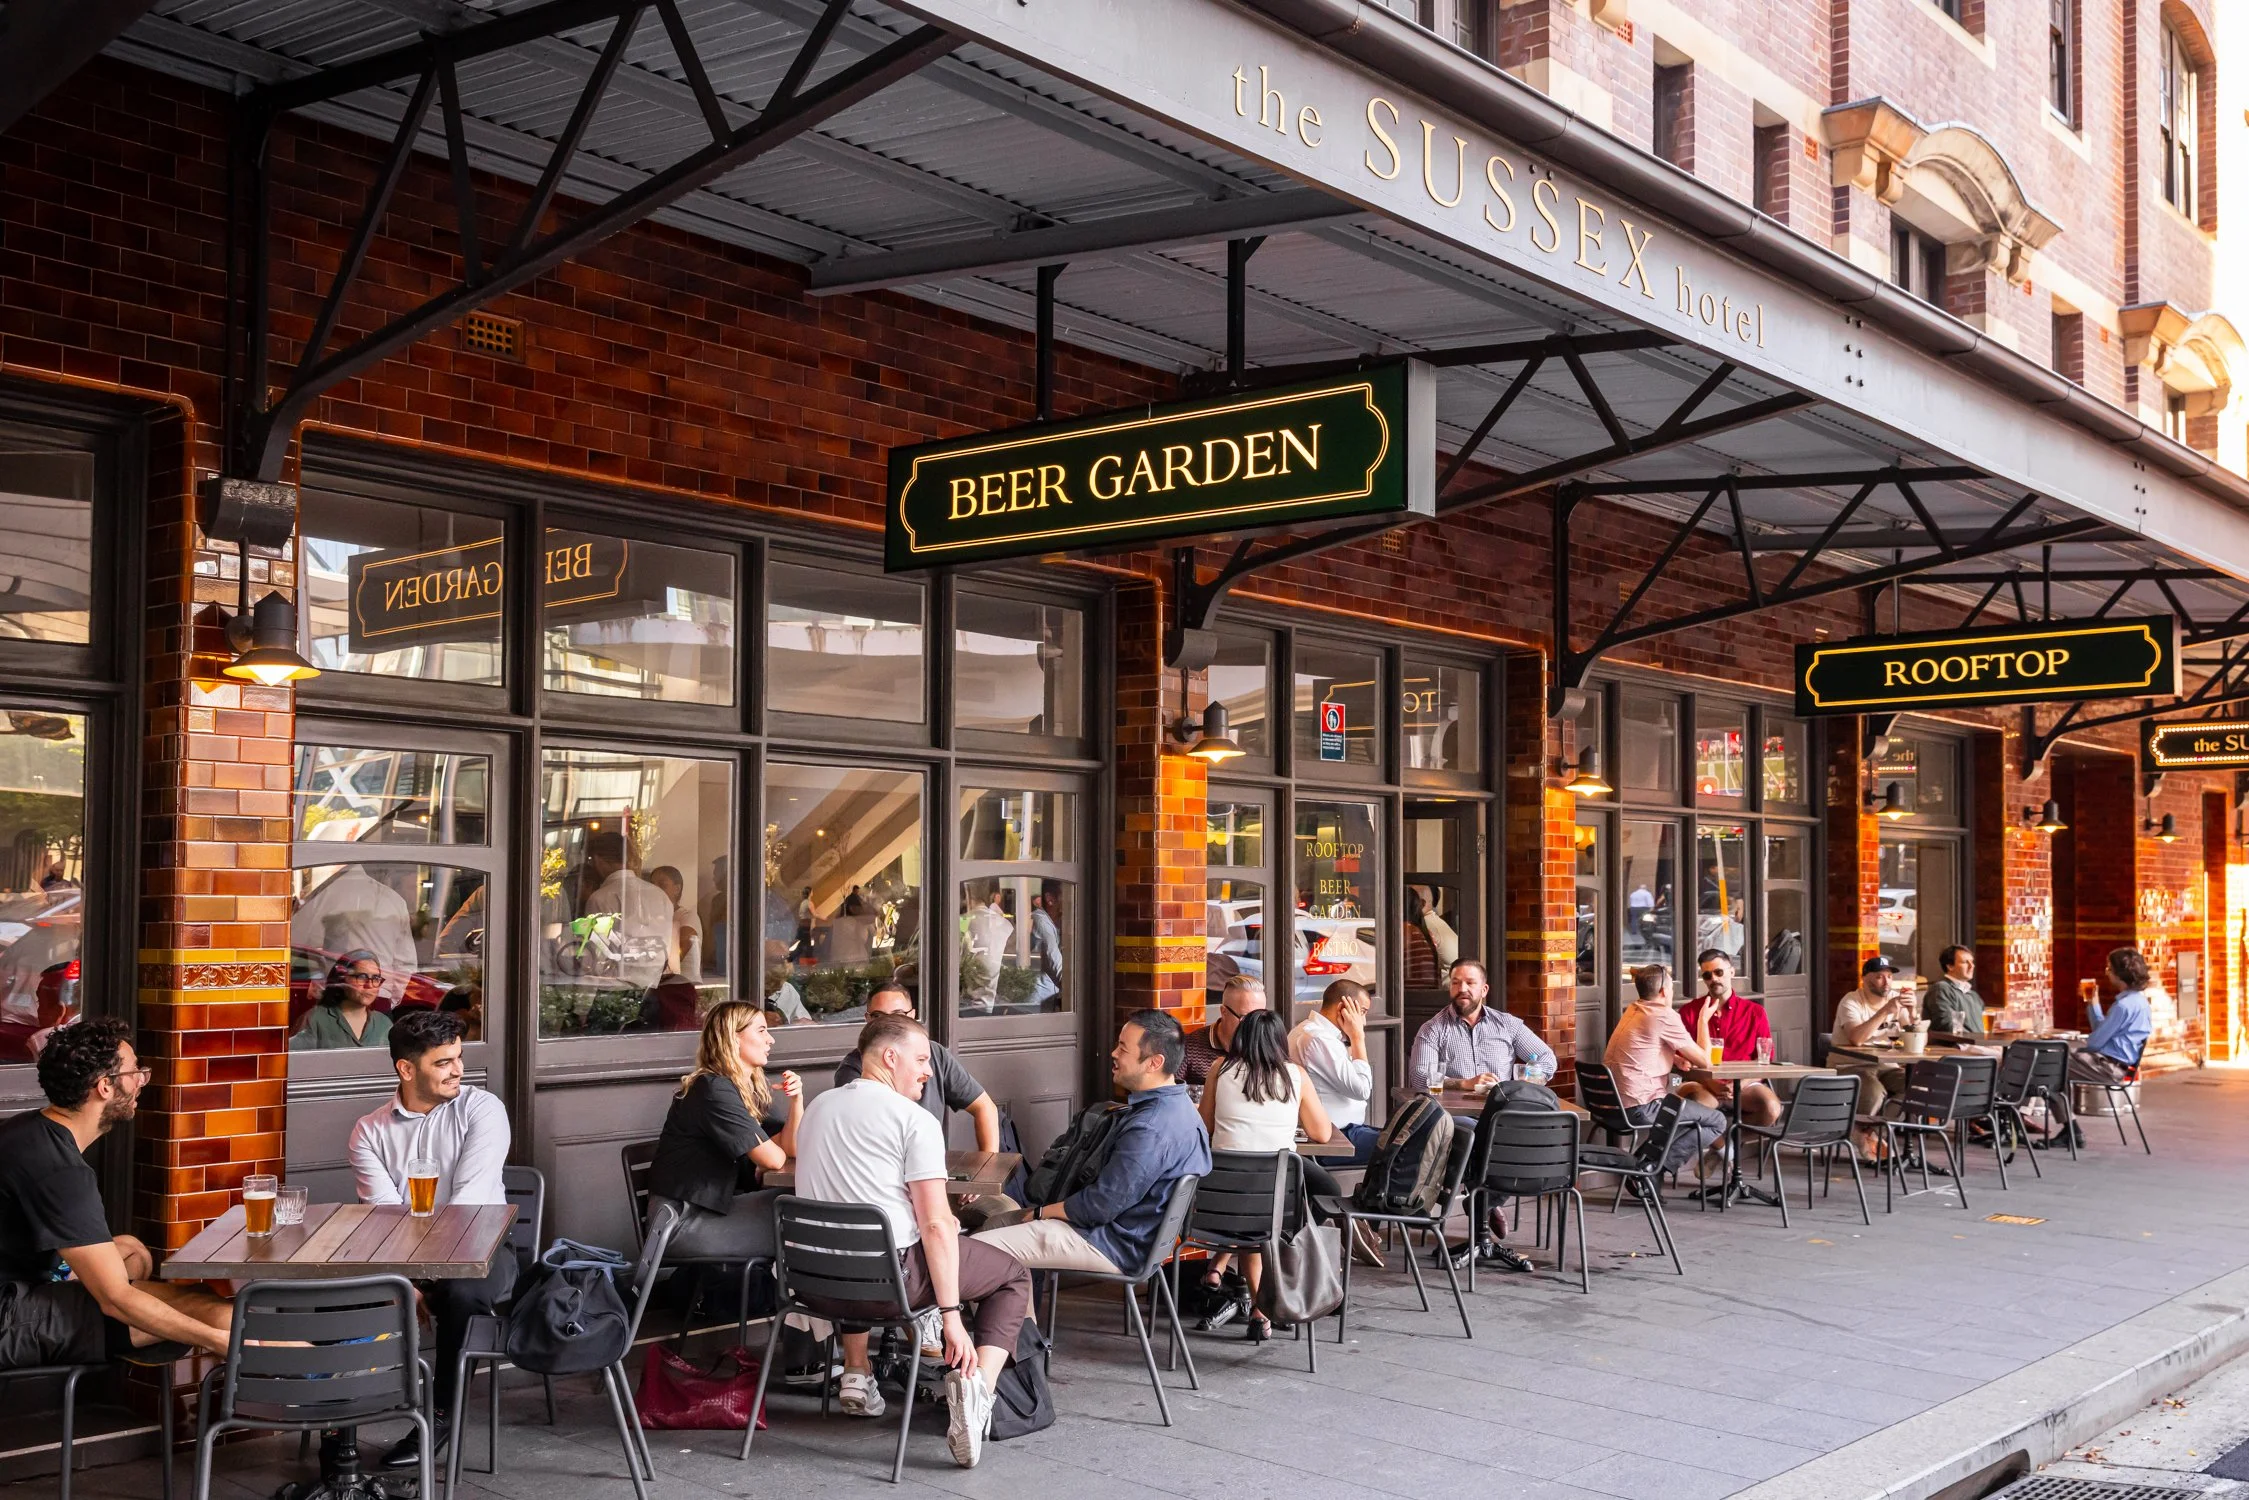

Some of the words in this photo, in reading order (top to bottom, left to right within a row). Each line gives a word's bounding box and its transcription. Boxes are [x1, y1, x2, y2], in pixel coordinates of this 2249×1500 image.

[1232, 64, 1323, 148] the
[1365, 97, 1656, 299] SUSSEX
[1676, 265, 1765, 349] hotel
[947, 464, 1073, 521] BEER
[1088, 423, 1324, 500] GARDEN
[1884, 649, 2070, 687] ROOFTOP
[2194, 738, 2220, 752] the
[1306, 842, 1364, 859] ROOFTOP
[1319, 879, 1351, 894] BEER
[1309, 904, 1361, 919] GARDEN
[1313, 941, 1358, 957] BISTRO
